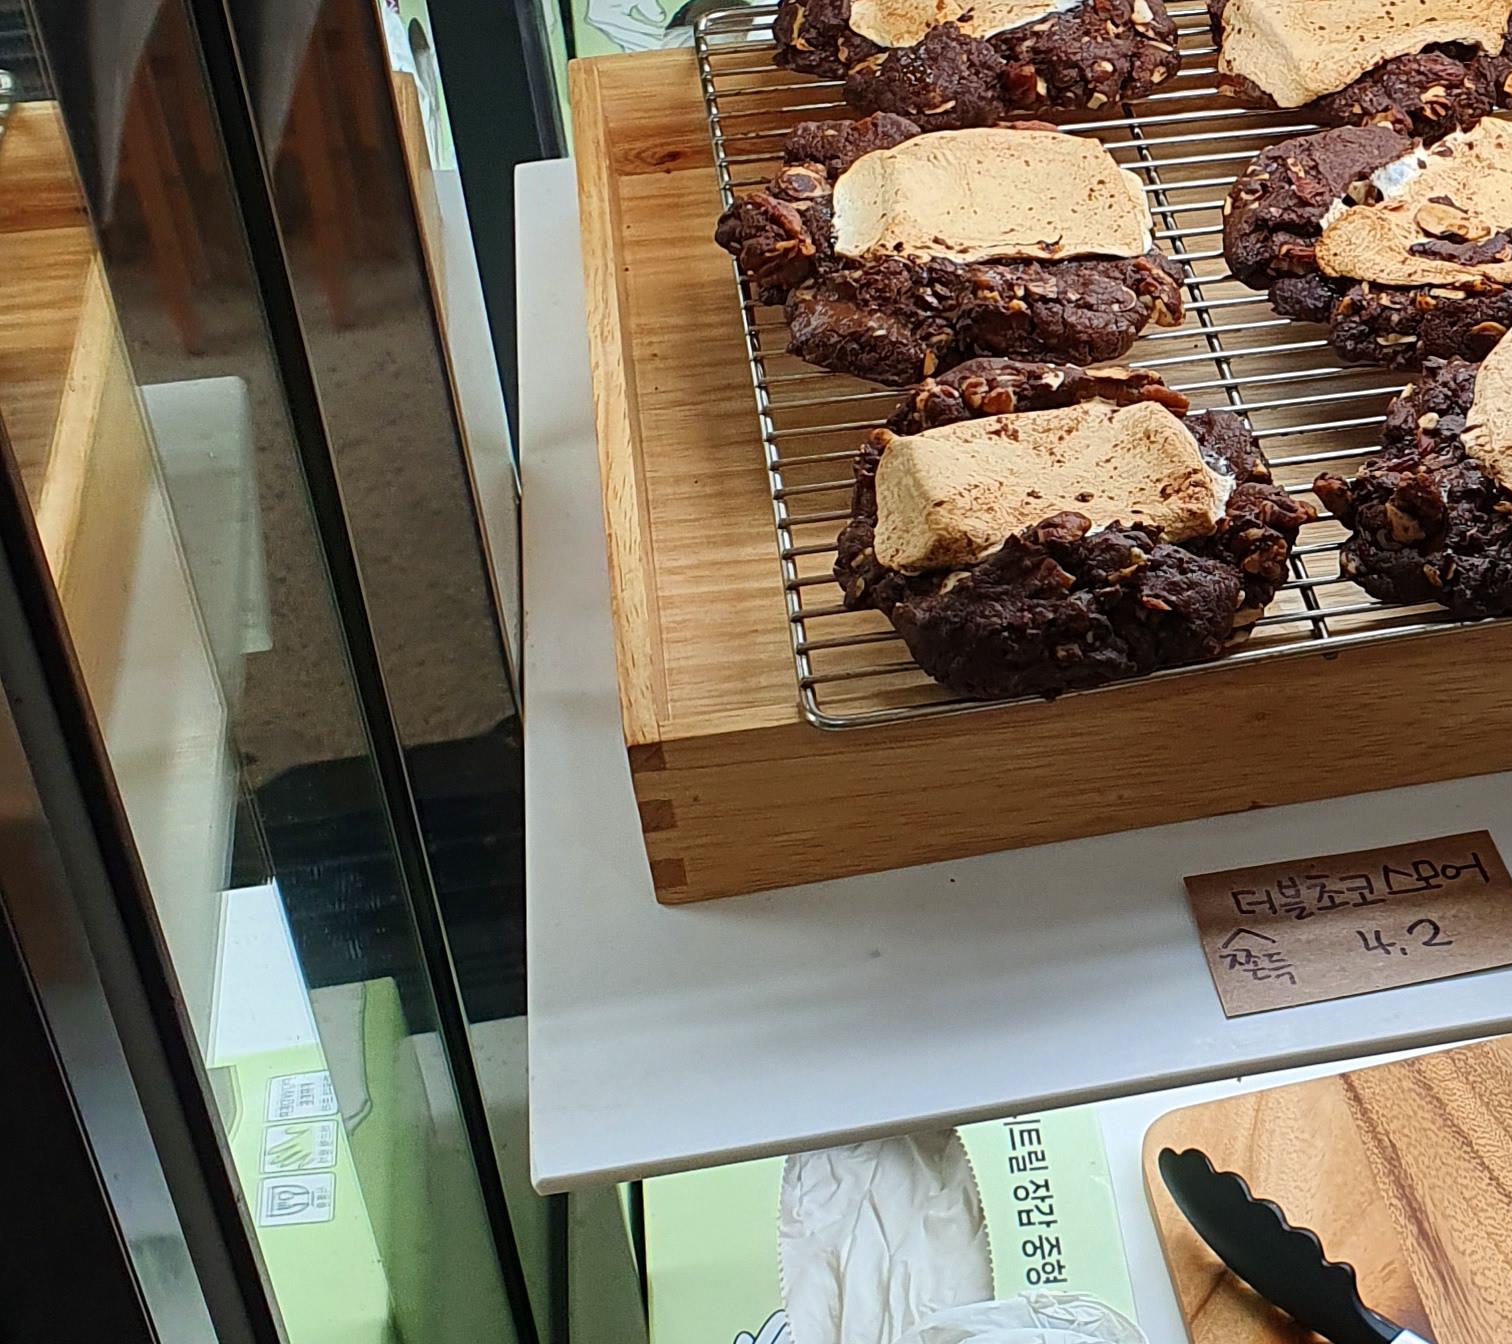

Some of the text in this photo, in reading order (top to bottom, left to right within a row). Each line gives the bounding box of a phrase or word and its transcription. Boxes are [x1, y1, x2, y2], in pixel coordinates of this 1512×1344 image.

[1355, 917, 1454, 957] 4.2
[1012, 1178, 1059, 1229] 장갑
[1021, 1233, 1069, 1286] 중형
